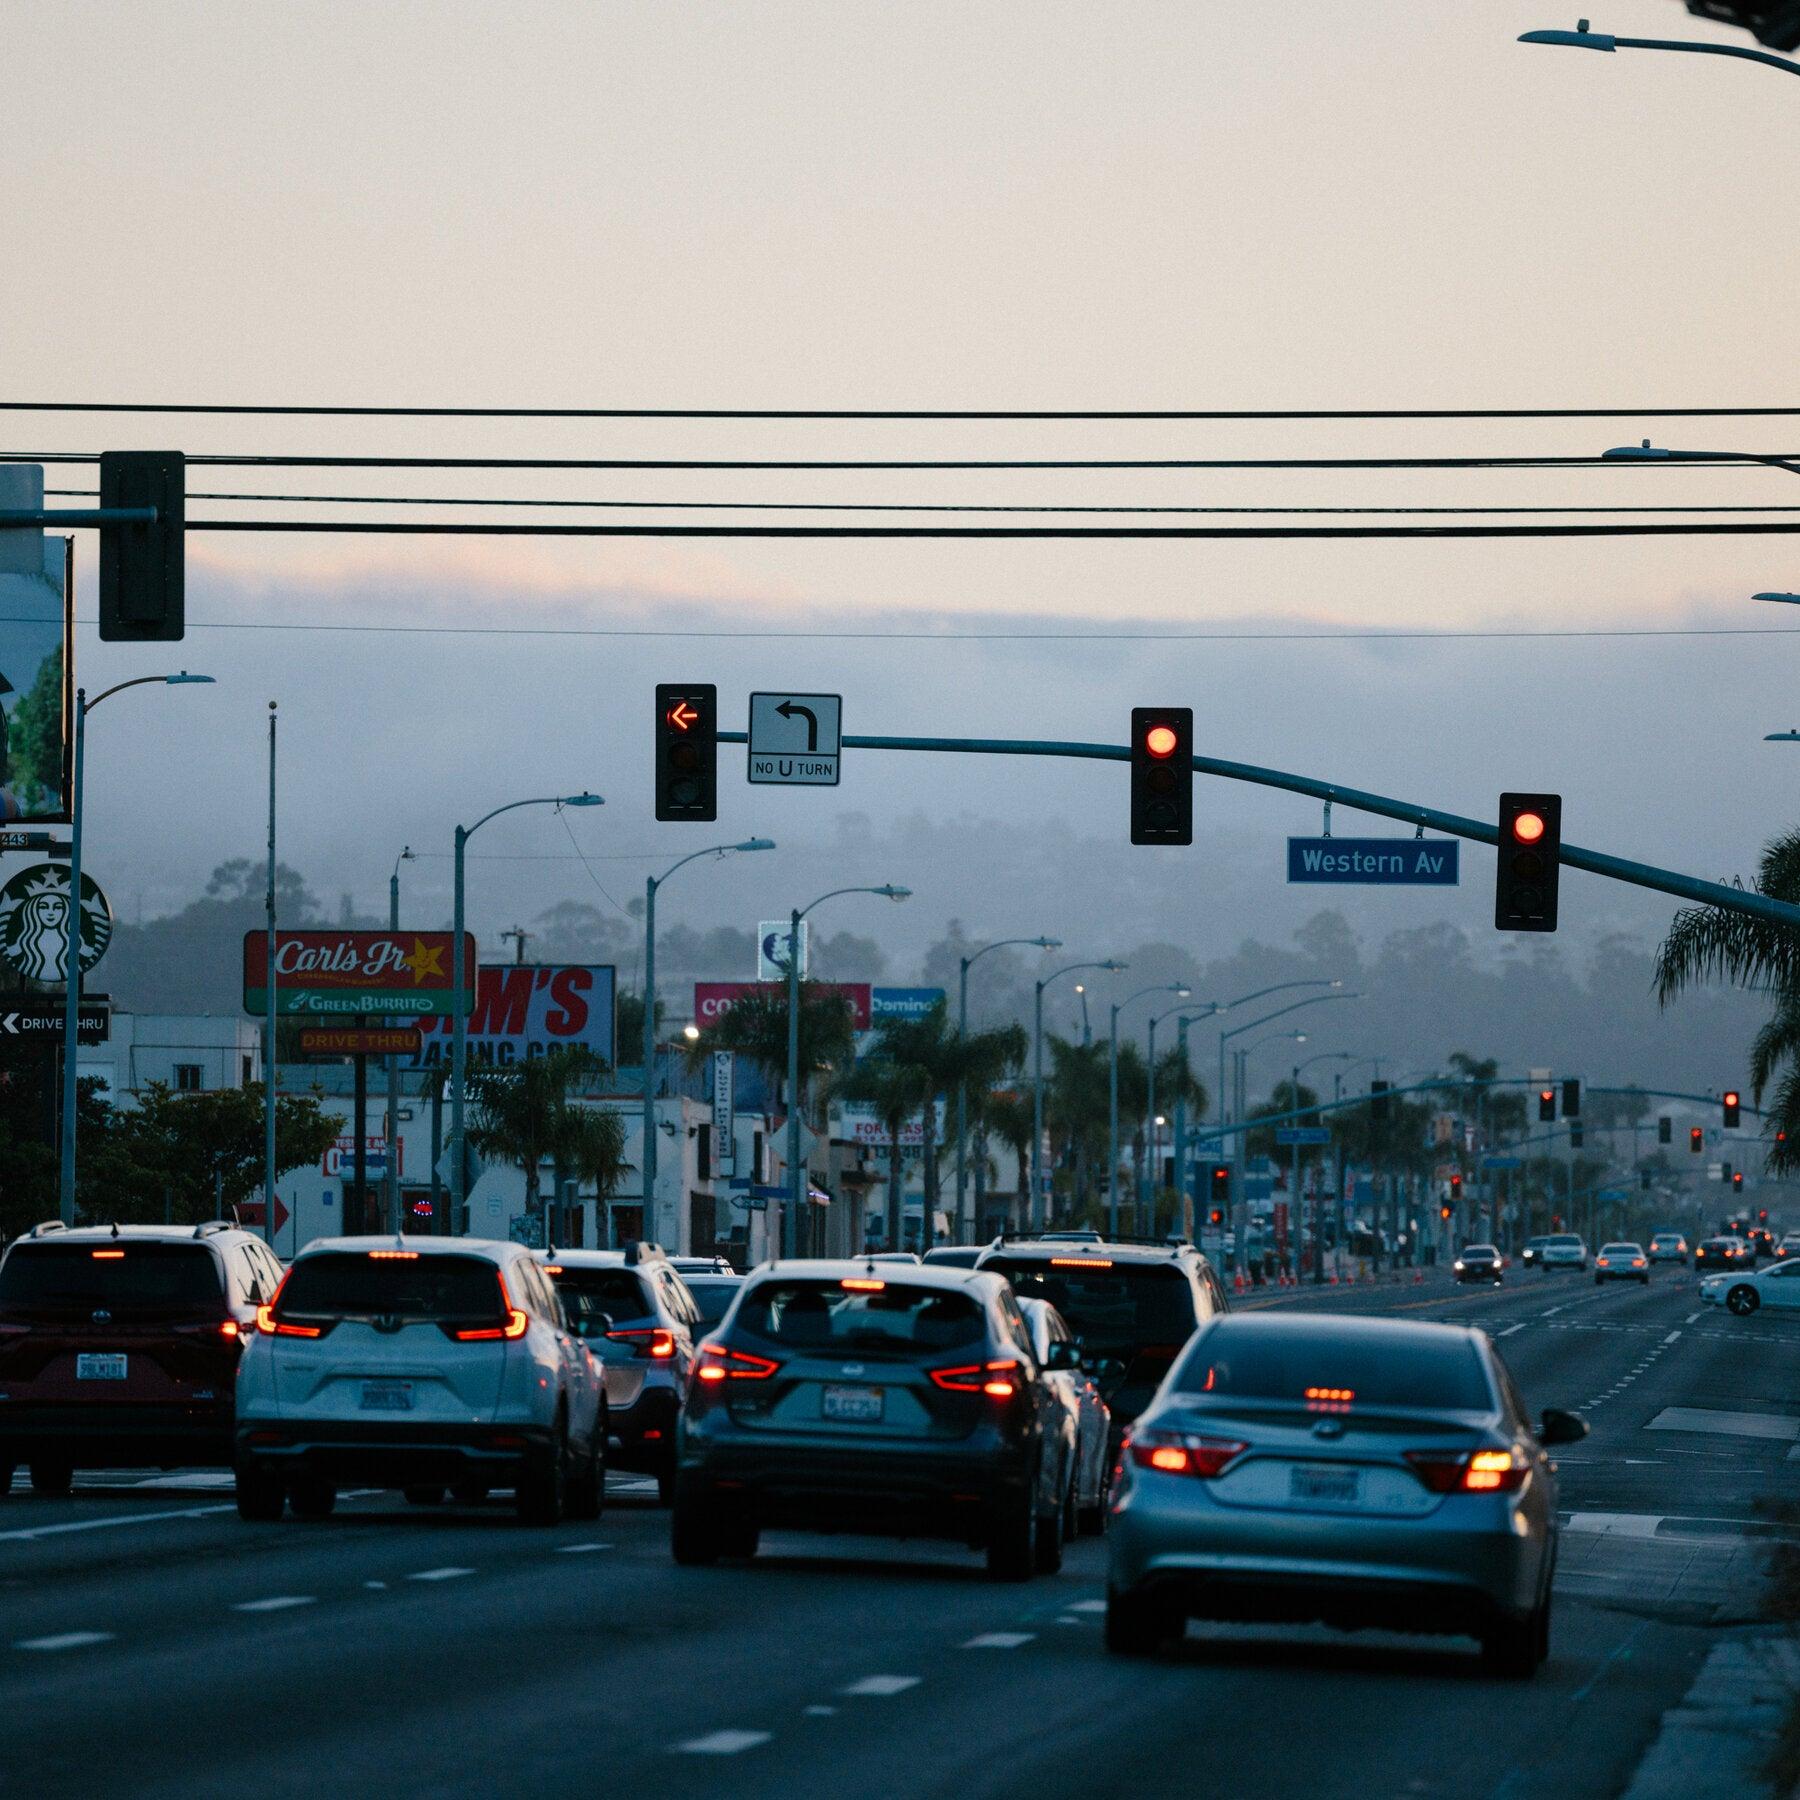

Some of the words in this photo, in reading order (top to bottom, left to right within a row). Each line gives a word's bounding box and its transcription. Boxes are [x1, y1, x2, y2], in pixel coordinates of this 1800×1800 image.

[756, 762, 773, 774] NO
[779, 760, 793, 776] U
[798, 763, 832, 775] TURN
[1303, 850, 1403, 872] Western
[1414, 851, 1445, 873] Av
[275, 940, 361, 974] Carl's
[22, 1018, 63, 1030] DRIVE
[77, 1018, 103, 1030] HRU
[303, 1034, 359, 1047] DRIVE
[367, 1034, 417, 1047] THRU
